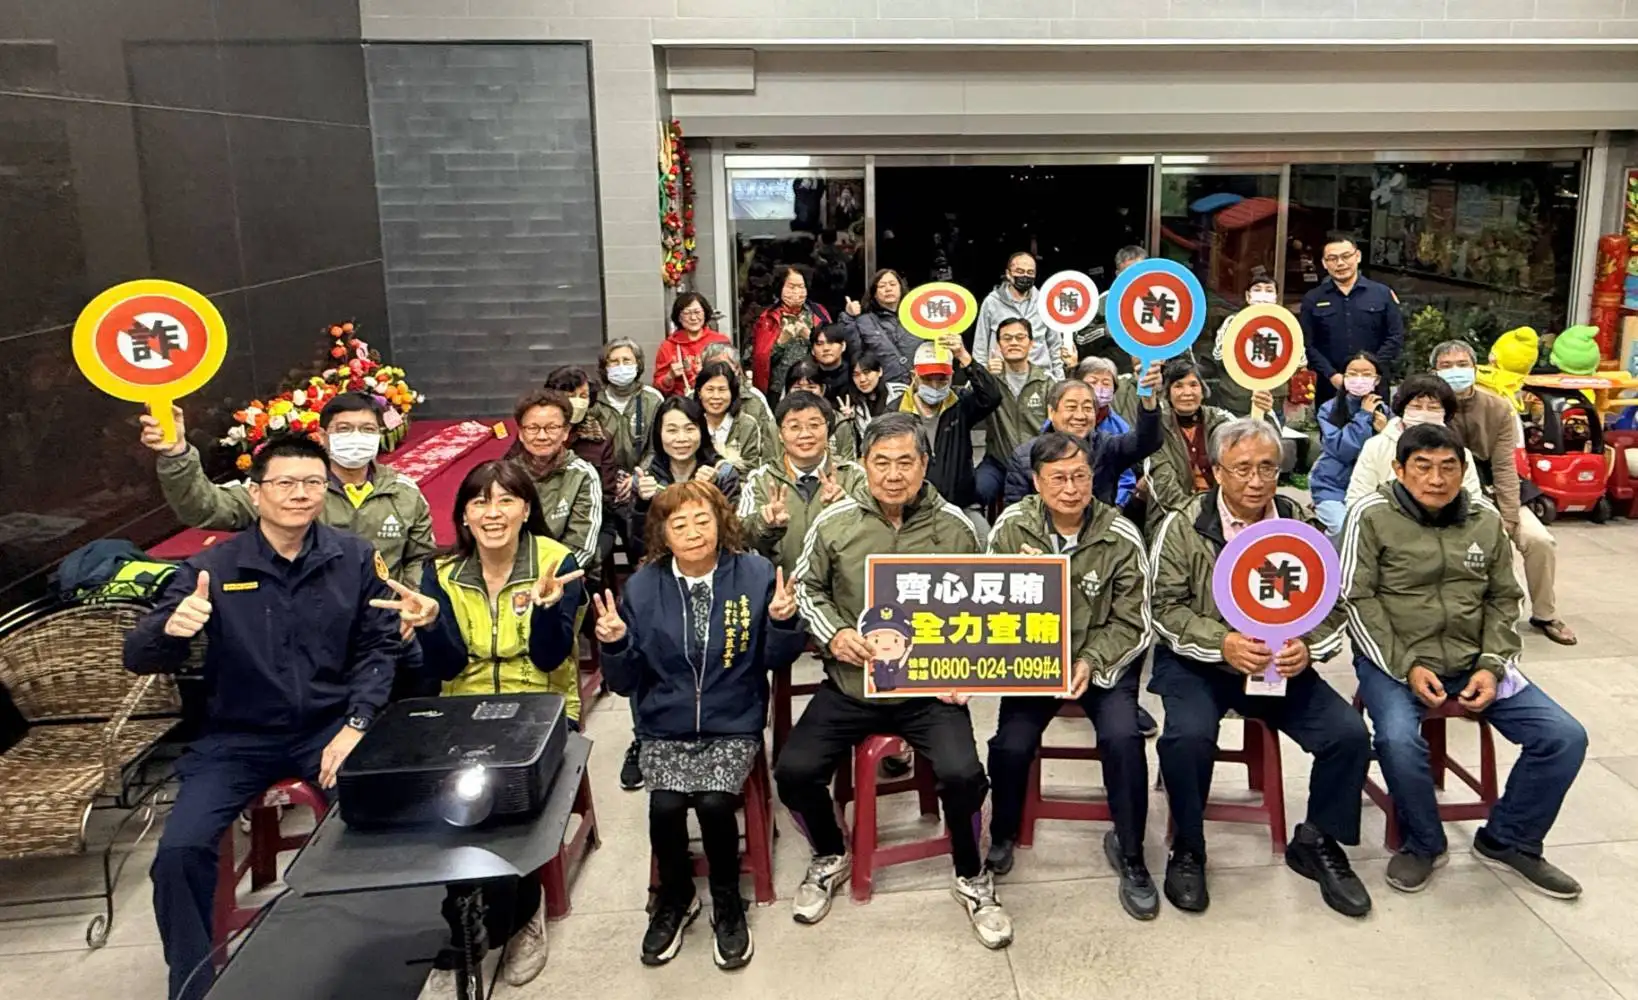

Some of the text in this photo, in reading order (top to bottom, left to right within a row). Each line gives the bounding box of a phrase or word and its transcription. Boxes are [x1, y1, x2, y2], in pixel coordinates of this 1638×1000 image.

[1141, 289, 1176, 327] 詐
[128, 320, 181, 362] 詐
[1251, 331, 1279, 363] 賄
[896, 572, 1044, 604] 齊心反賄
[1257, 560, 1301, 601] 詐
[911, 612, 1060, 644] 全力查賄
[930, 656, 1060, 679] 0800-024-099#4
